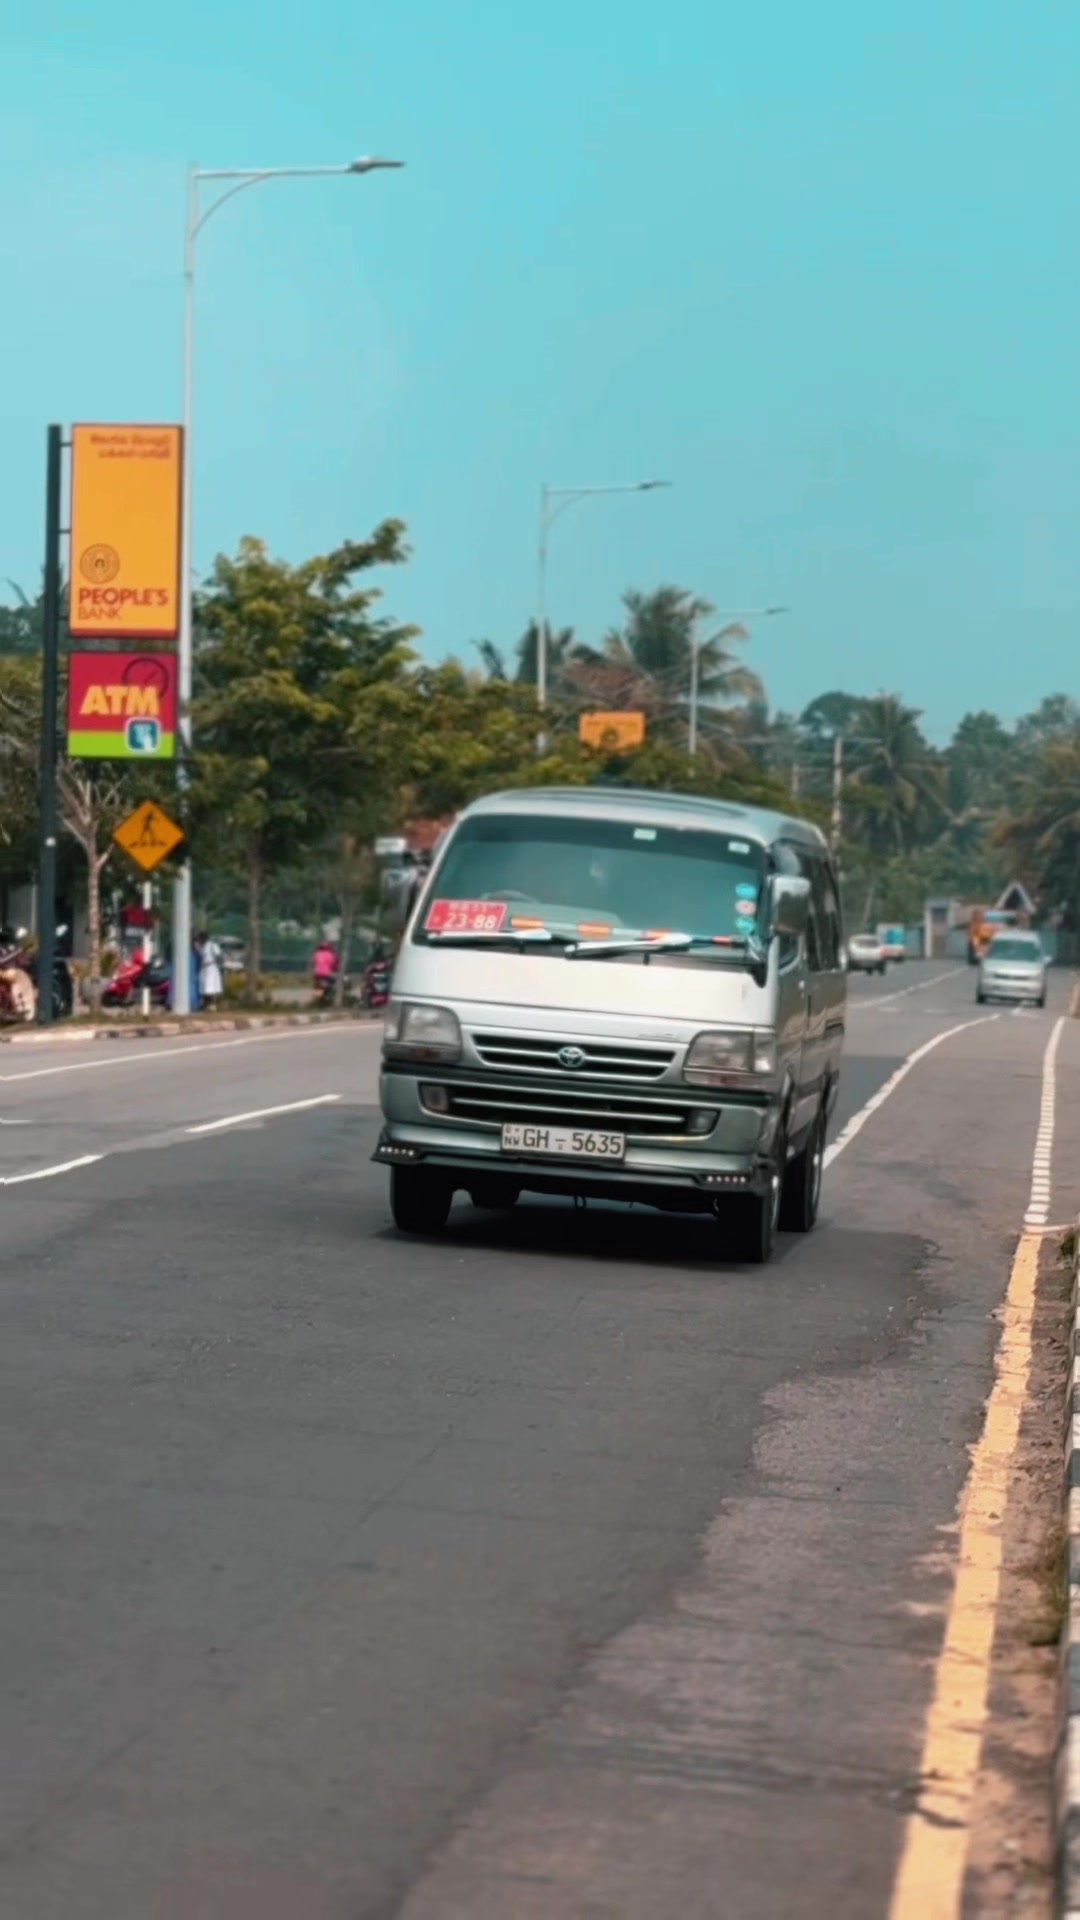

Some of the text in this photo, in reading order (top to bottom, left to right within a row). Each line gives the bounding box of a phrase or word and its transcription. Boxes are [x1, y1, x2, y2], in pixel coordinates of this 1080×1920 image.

[78, 605, 122, 621] BANK
[79, 685, 160, 716] ATM
[523, 1128, 550, 1149] GH
[571, 1132, 622, 1154] 5635
